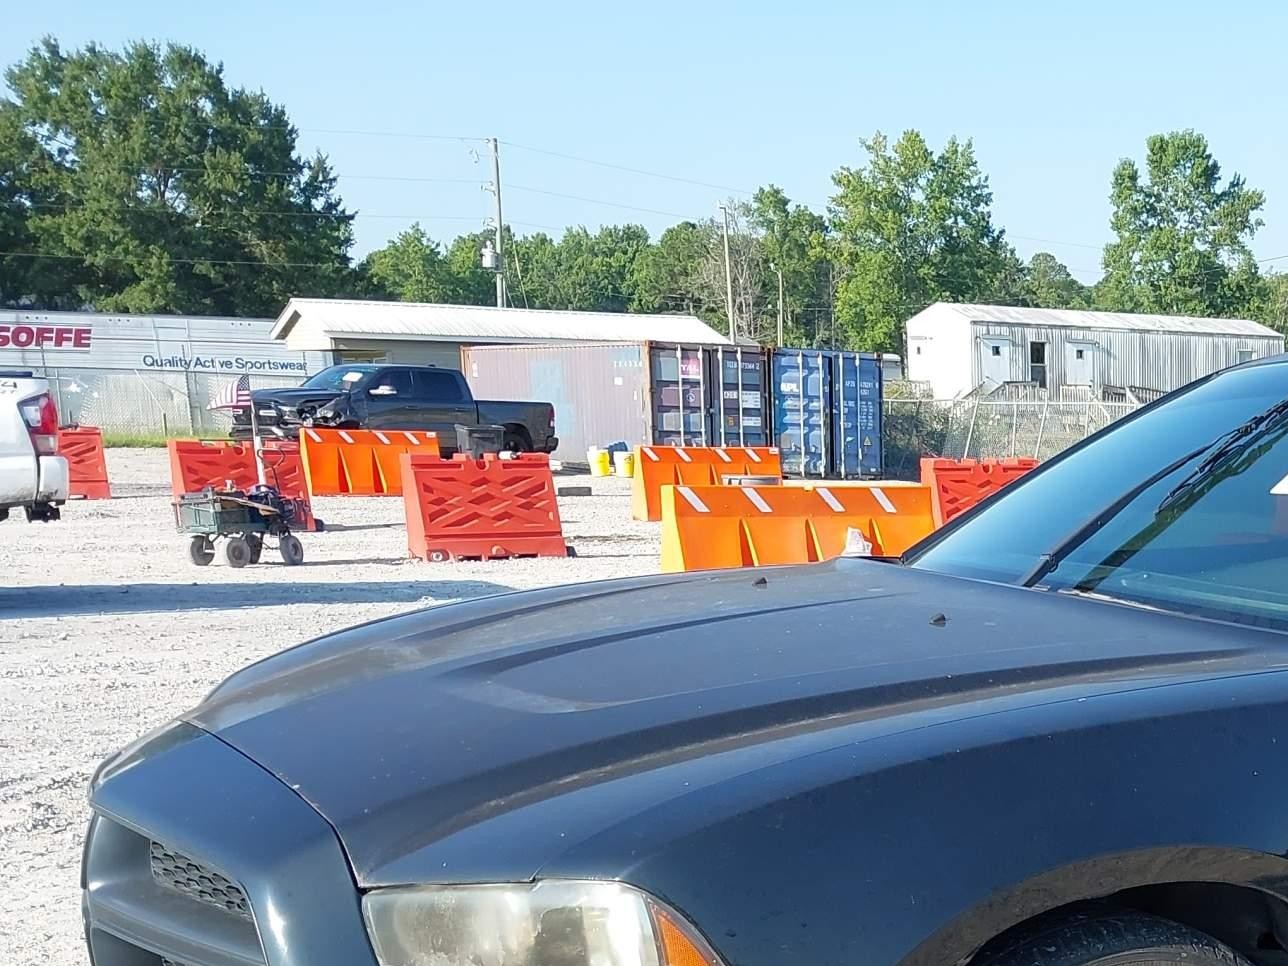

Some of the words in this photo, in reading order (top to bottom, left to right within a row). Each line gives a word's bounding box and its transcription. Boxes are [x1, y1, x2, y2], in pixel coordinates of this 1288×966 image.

[143, 355, 191, 370] Quality
[194, 356, 233, 369] Actve
[235, 357, 307, 371] Sportswear
